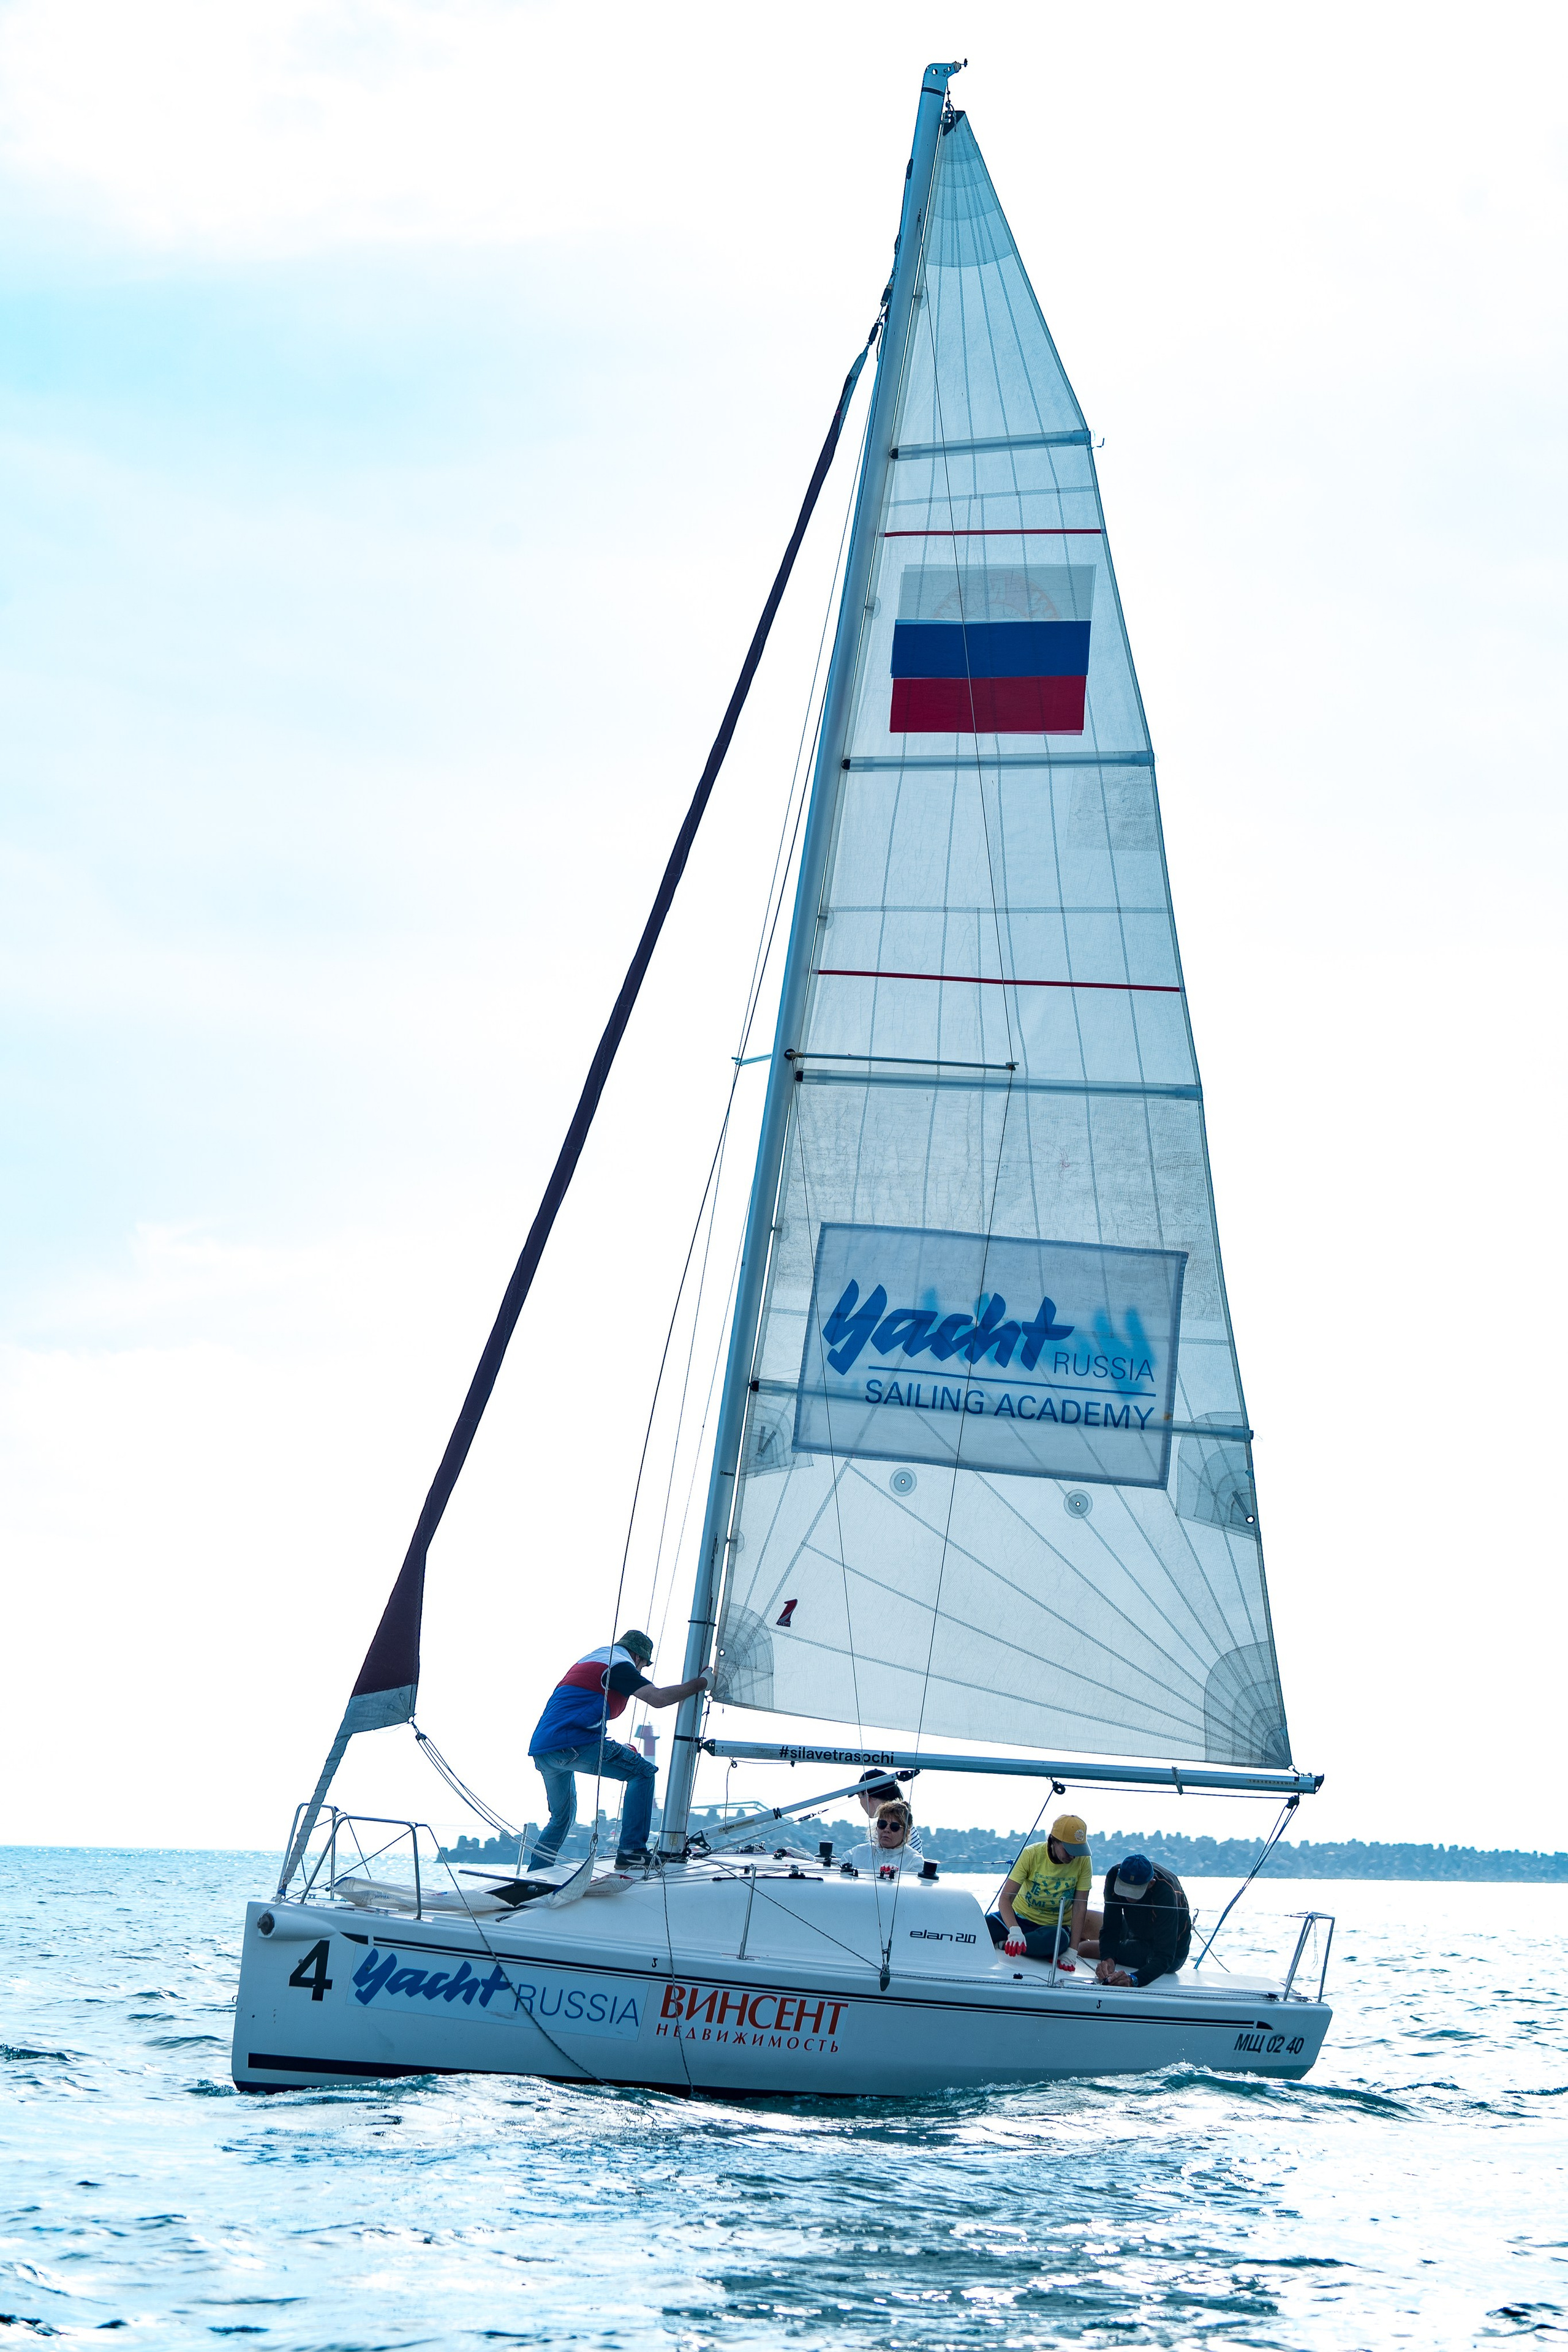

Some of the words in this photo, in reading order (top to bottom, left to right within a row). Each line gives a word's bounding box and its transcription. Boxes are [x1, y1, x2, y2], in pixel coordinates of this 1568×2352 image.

[1053, 1351, 1155, 1382] RUSSIA
[864, 1379, 985, 1415] SAILING
[993, 1393, 1155, 1431] ACADEMY
[779, 1746, 894, 1764] #silavetrasochi
[910, 1929, 954, 1942] elan
[955, 1932, 977, 1944] 210
[288, 1940, 333, 2002] 4
[513, 1983, 639, 2027] RUSSIA
[660, 1985, 849, 2035] ВИНСЕНТ
[655, 2023, 839, 2052] НЕДВИЖИМОСТЬ
[1233, 2033, 1265, 2053] МЩ
[1266, 2035, 1285, 2053] 02
[1286, 2037, 1305, 2054] 40
